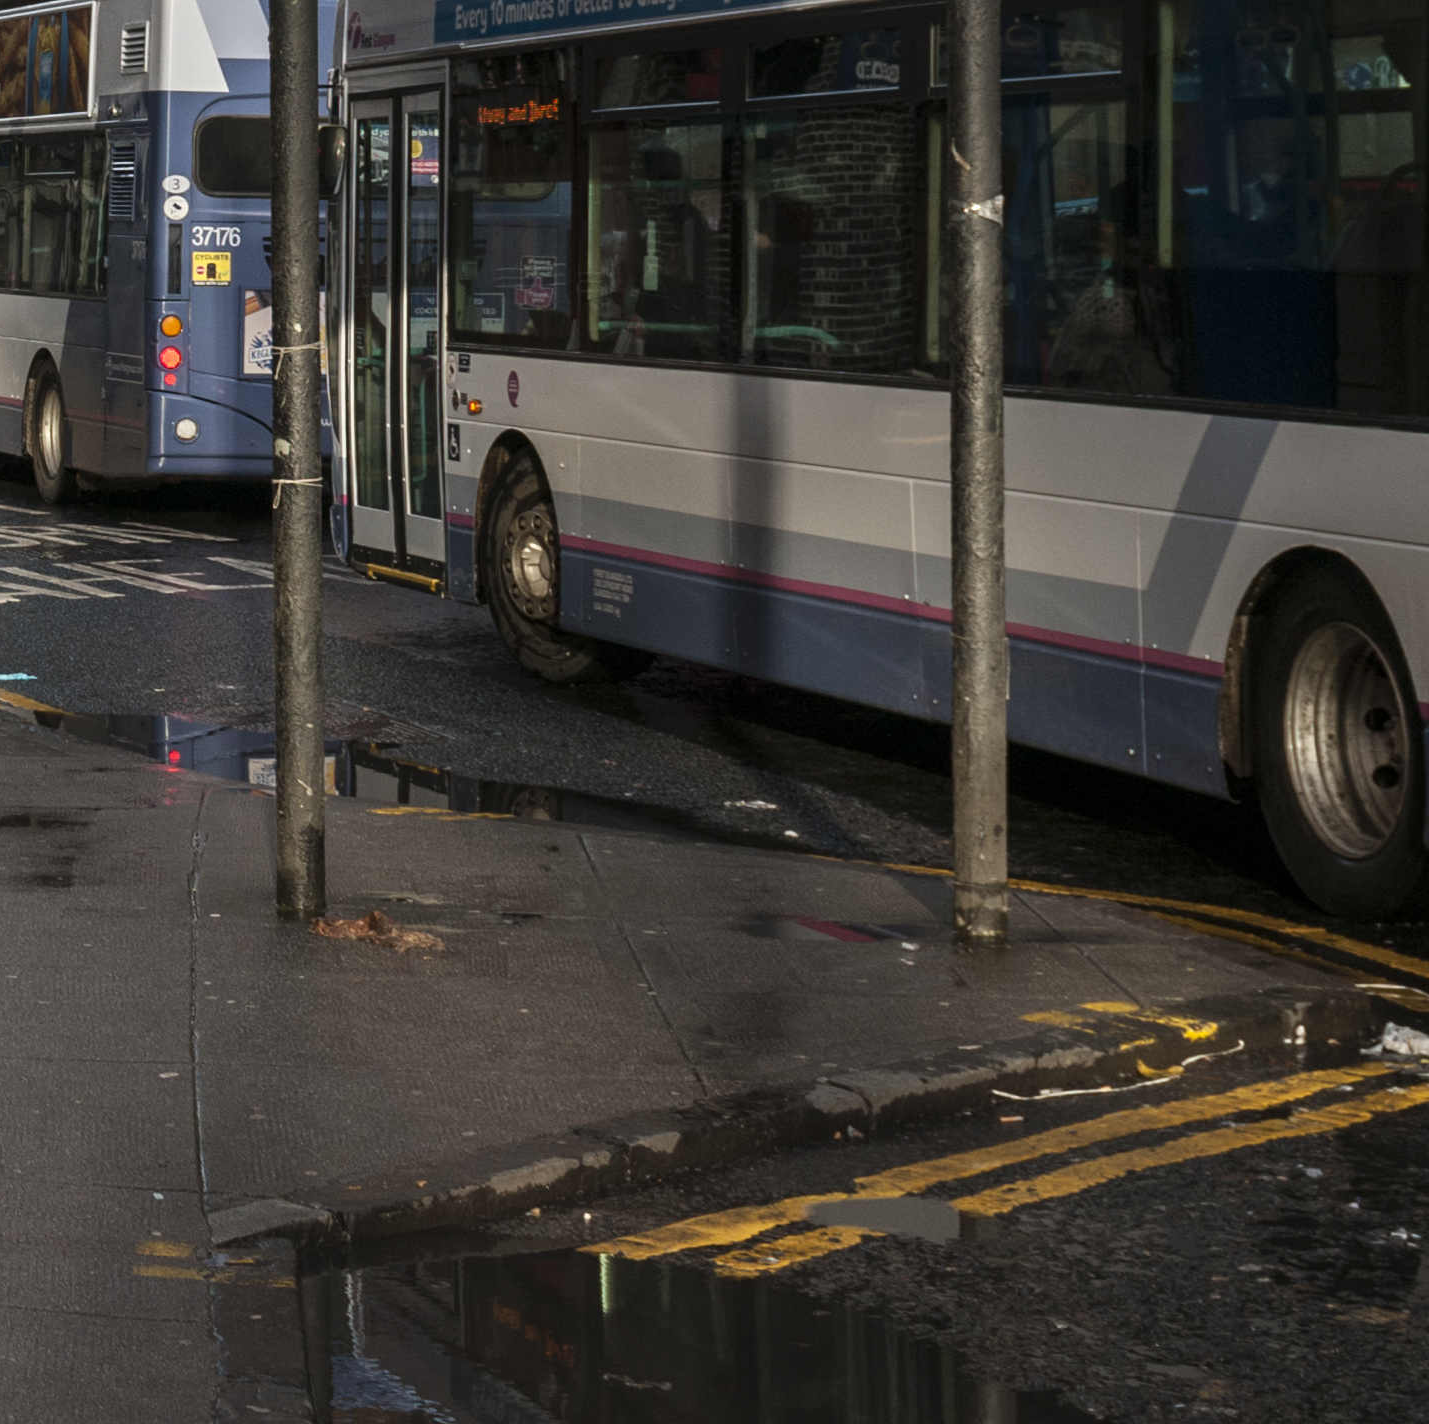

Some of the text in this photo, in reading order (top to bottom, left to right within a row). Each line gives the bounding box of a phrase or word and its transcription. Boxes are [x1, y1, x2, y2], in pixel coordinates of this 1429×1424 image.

[455, 3, 489, 35] Every
[491, 0, 504, 26] 10
[172, 178, 181, 191] 3
[191, 225, 242, 247] 37176
[194, 253, 230, 261] CYCLISTS
